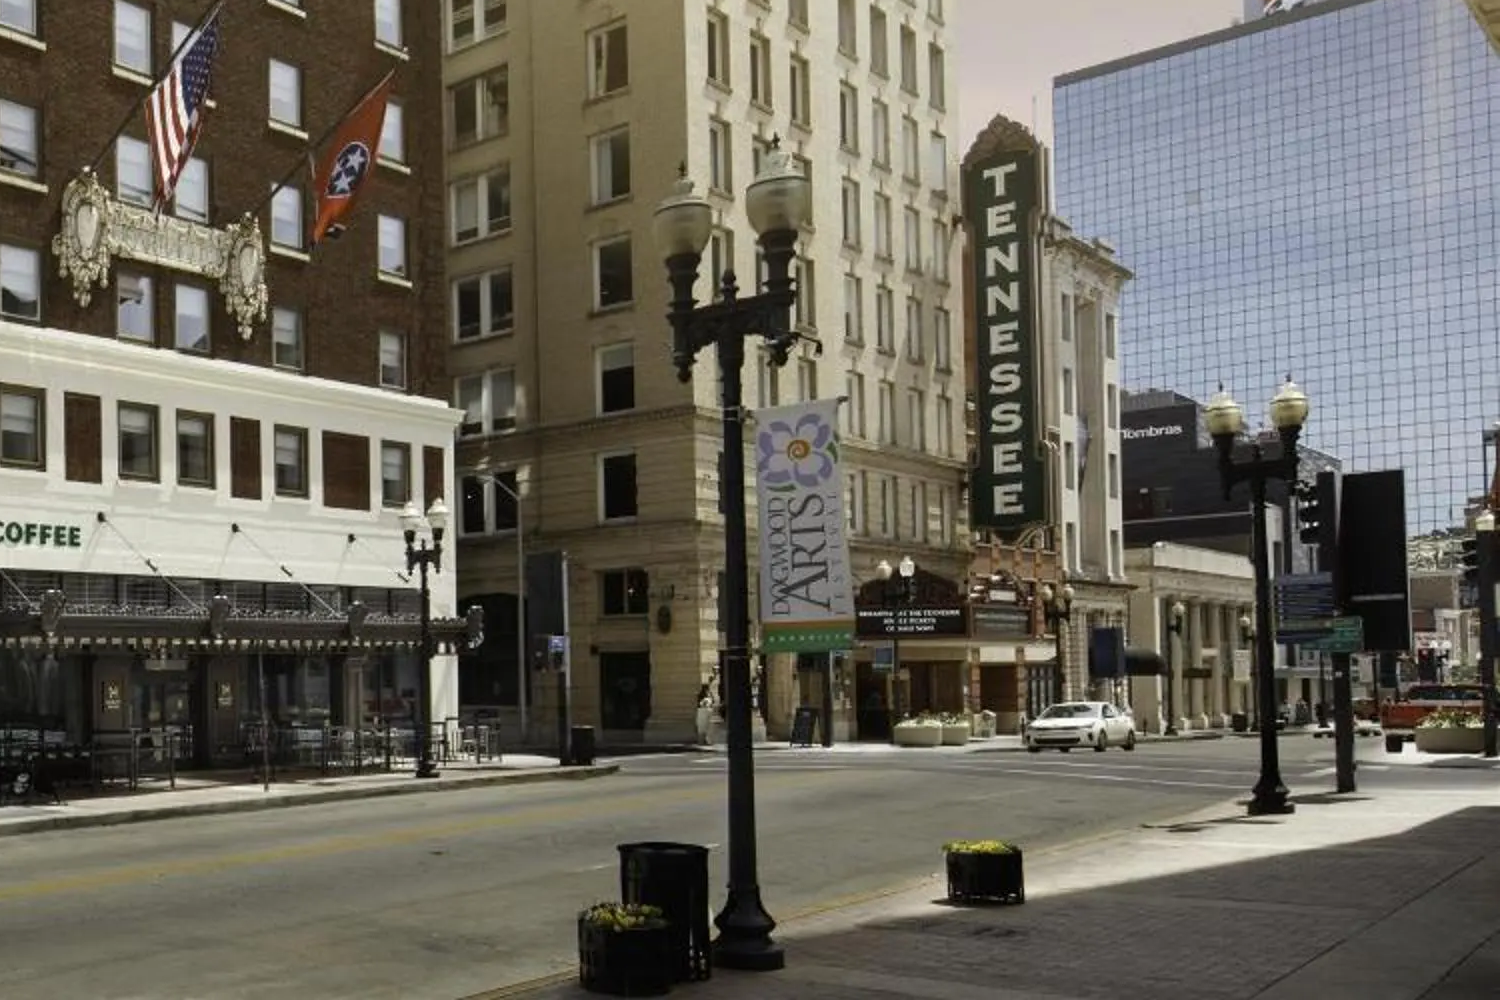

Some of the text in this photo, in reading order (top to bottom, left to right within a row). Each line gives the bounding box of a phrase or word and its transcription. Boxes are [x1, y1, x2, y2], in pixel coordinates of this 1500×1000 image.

[982, 161, 1025, 516] TENNESSEE
[1117, 425, 1182, 439] Tombras
[767, 496, 790, 616] DOGWOOD
[778, 493, 832, 612] ARTS
